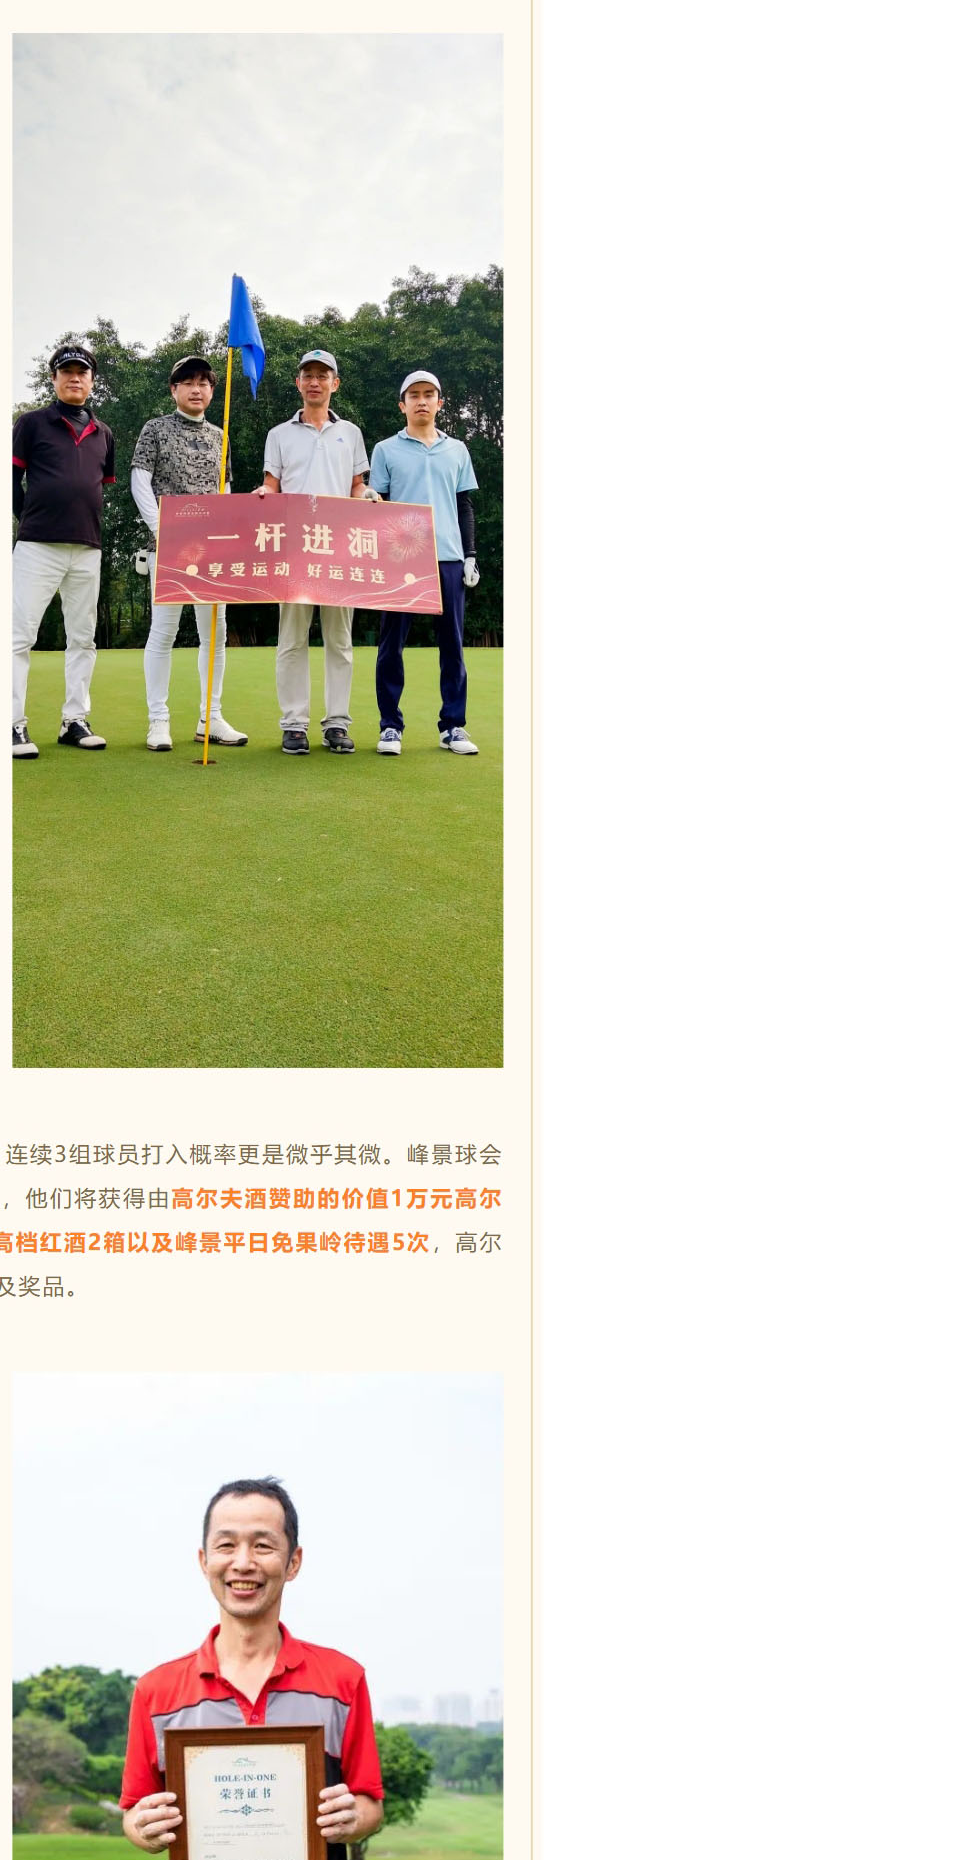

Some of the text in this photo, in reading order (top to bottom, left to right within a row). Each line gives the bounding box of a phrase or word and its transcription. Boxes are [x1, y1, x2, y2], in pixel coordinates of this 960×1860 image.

[207, 522, 379, 560] 一杆进洞
[208, 561, 386, 584] 享受运动 好运连连
[214, 1773, 277, 1782] HOLE-IN-ONE
[220, 1787, 271, 1800] 荣誉证书
